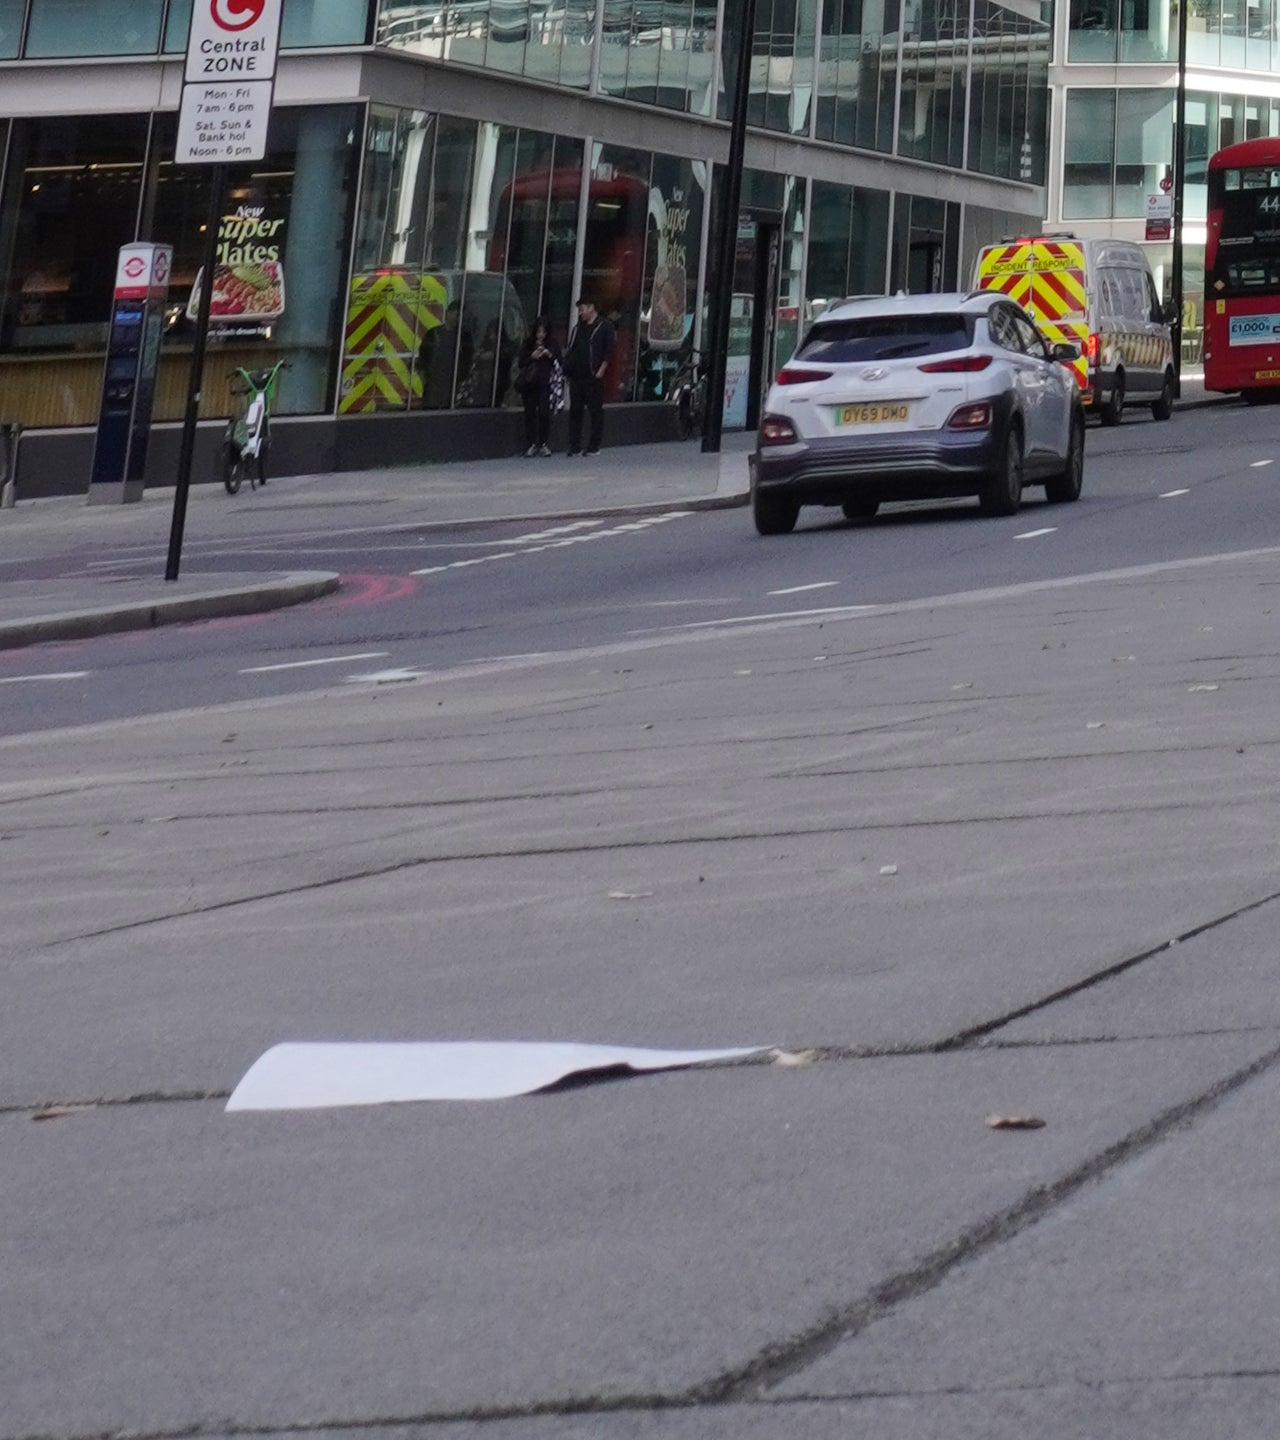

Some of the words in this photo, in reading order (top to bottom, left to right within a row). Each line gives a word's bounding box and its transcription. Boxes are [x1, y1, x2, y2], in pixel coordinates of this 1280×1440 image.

[200, 37, 265, 53] Central
[203, 57, 257, 72] ZONE
[220, 121, 241, 130] Sun
[199, 132, 225, 142] Bank
[229, 132, 246, 141] hol
[189, 147, 218, 156] Noon
[1260, 196, 1280, 212] 44
[235, 205, 264, 218] New
[992, 263, 1027, 271] INCIDENT
